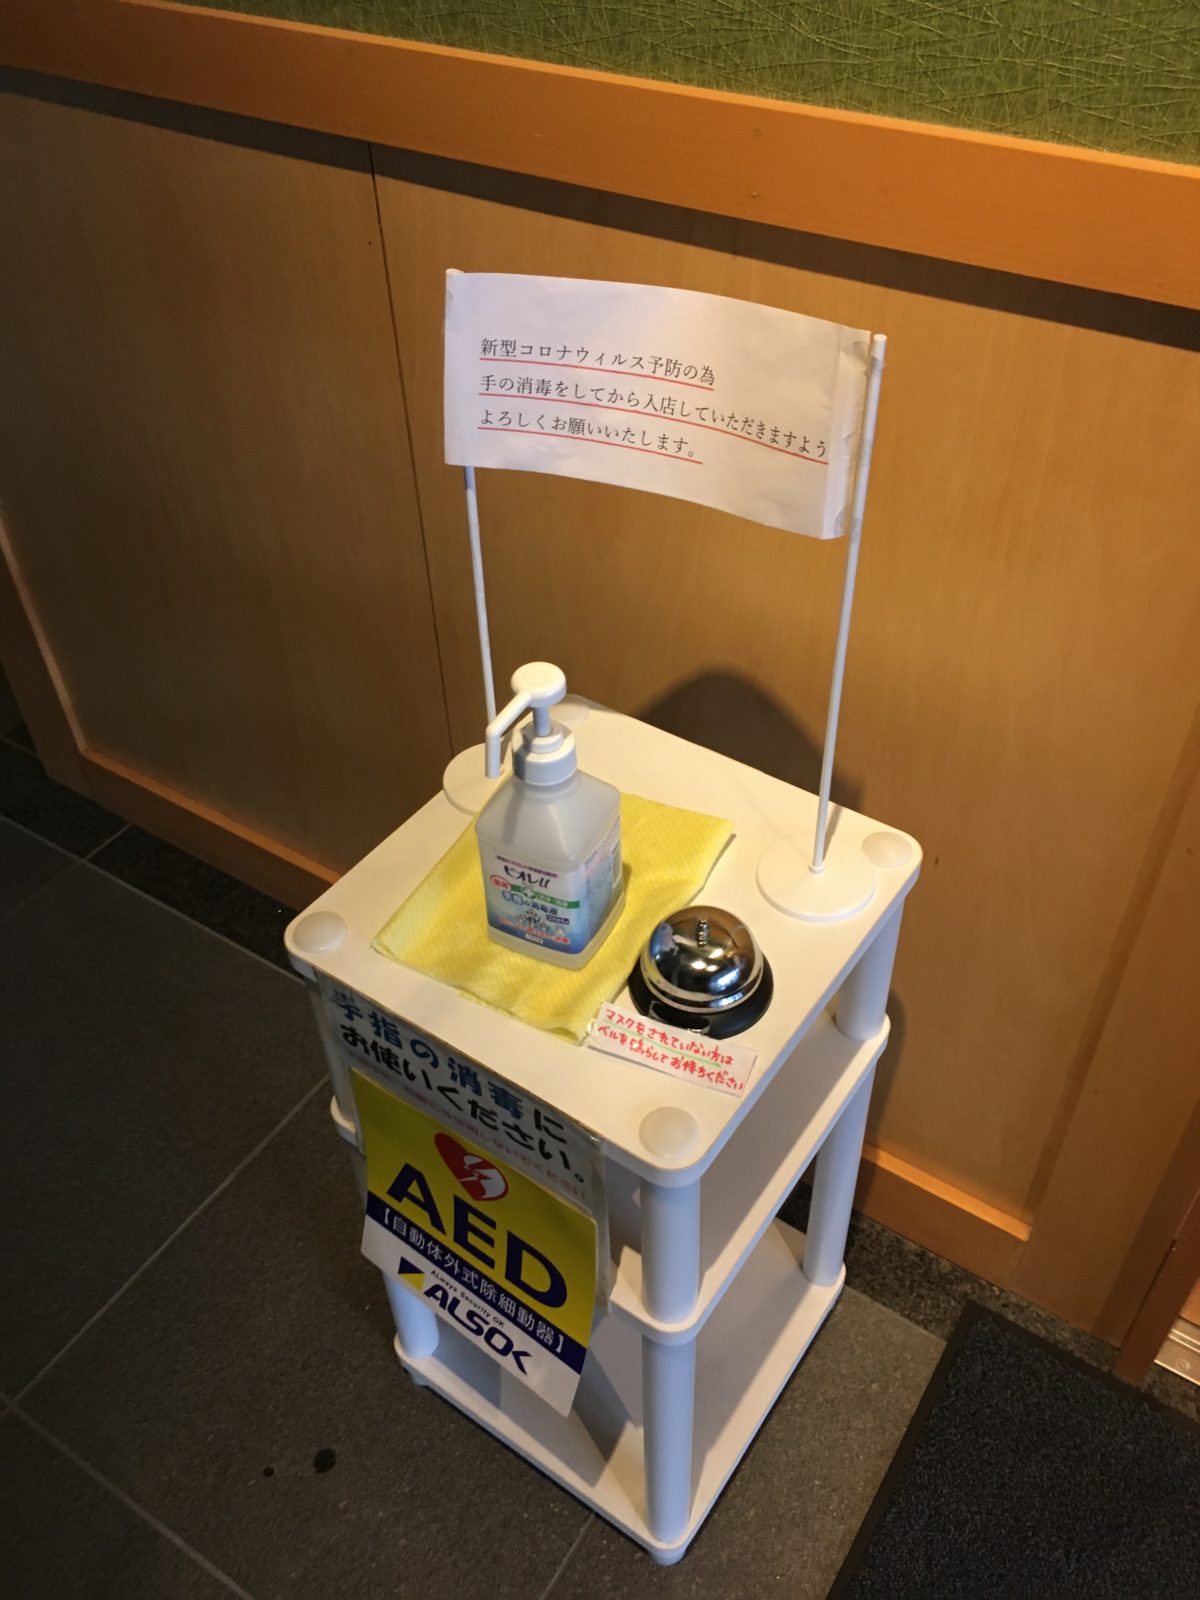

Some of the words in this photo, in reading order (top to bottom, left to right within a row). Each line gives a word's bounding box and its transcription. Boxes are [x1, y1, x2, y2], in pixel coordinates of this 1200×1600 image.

[480, 337, 715, 386] 新型コロナウィルス予防の為
[480, 374, 829, 458] 手の消毒をしてから入店していただきますよう
[480, 409, 695, 458] よろしくお願いいたします。
[332, 989, 568, 1144] 手指の消毒に
[605, 1008, 734, 1066] マスクをされていない方は
[340, 1023, 585, 1184] お使いください。
[386, 1162, 568, 1309] AED
[423, 1283, 533, 1376] ALSOK
[460, 1291, 492, 1319] Security
[492, 1315, 506, 1329] OK
